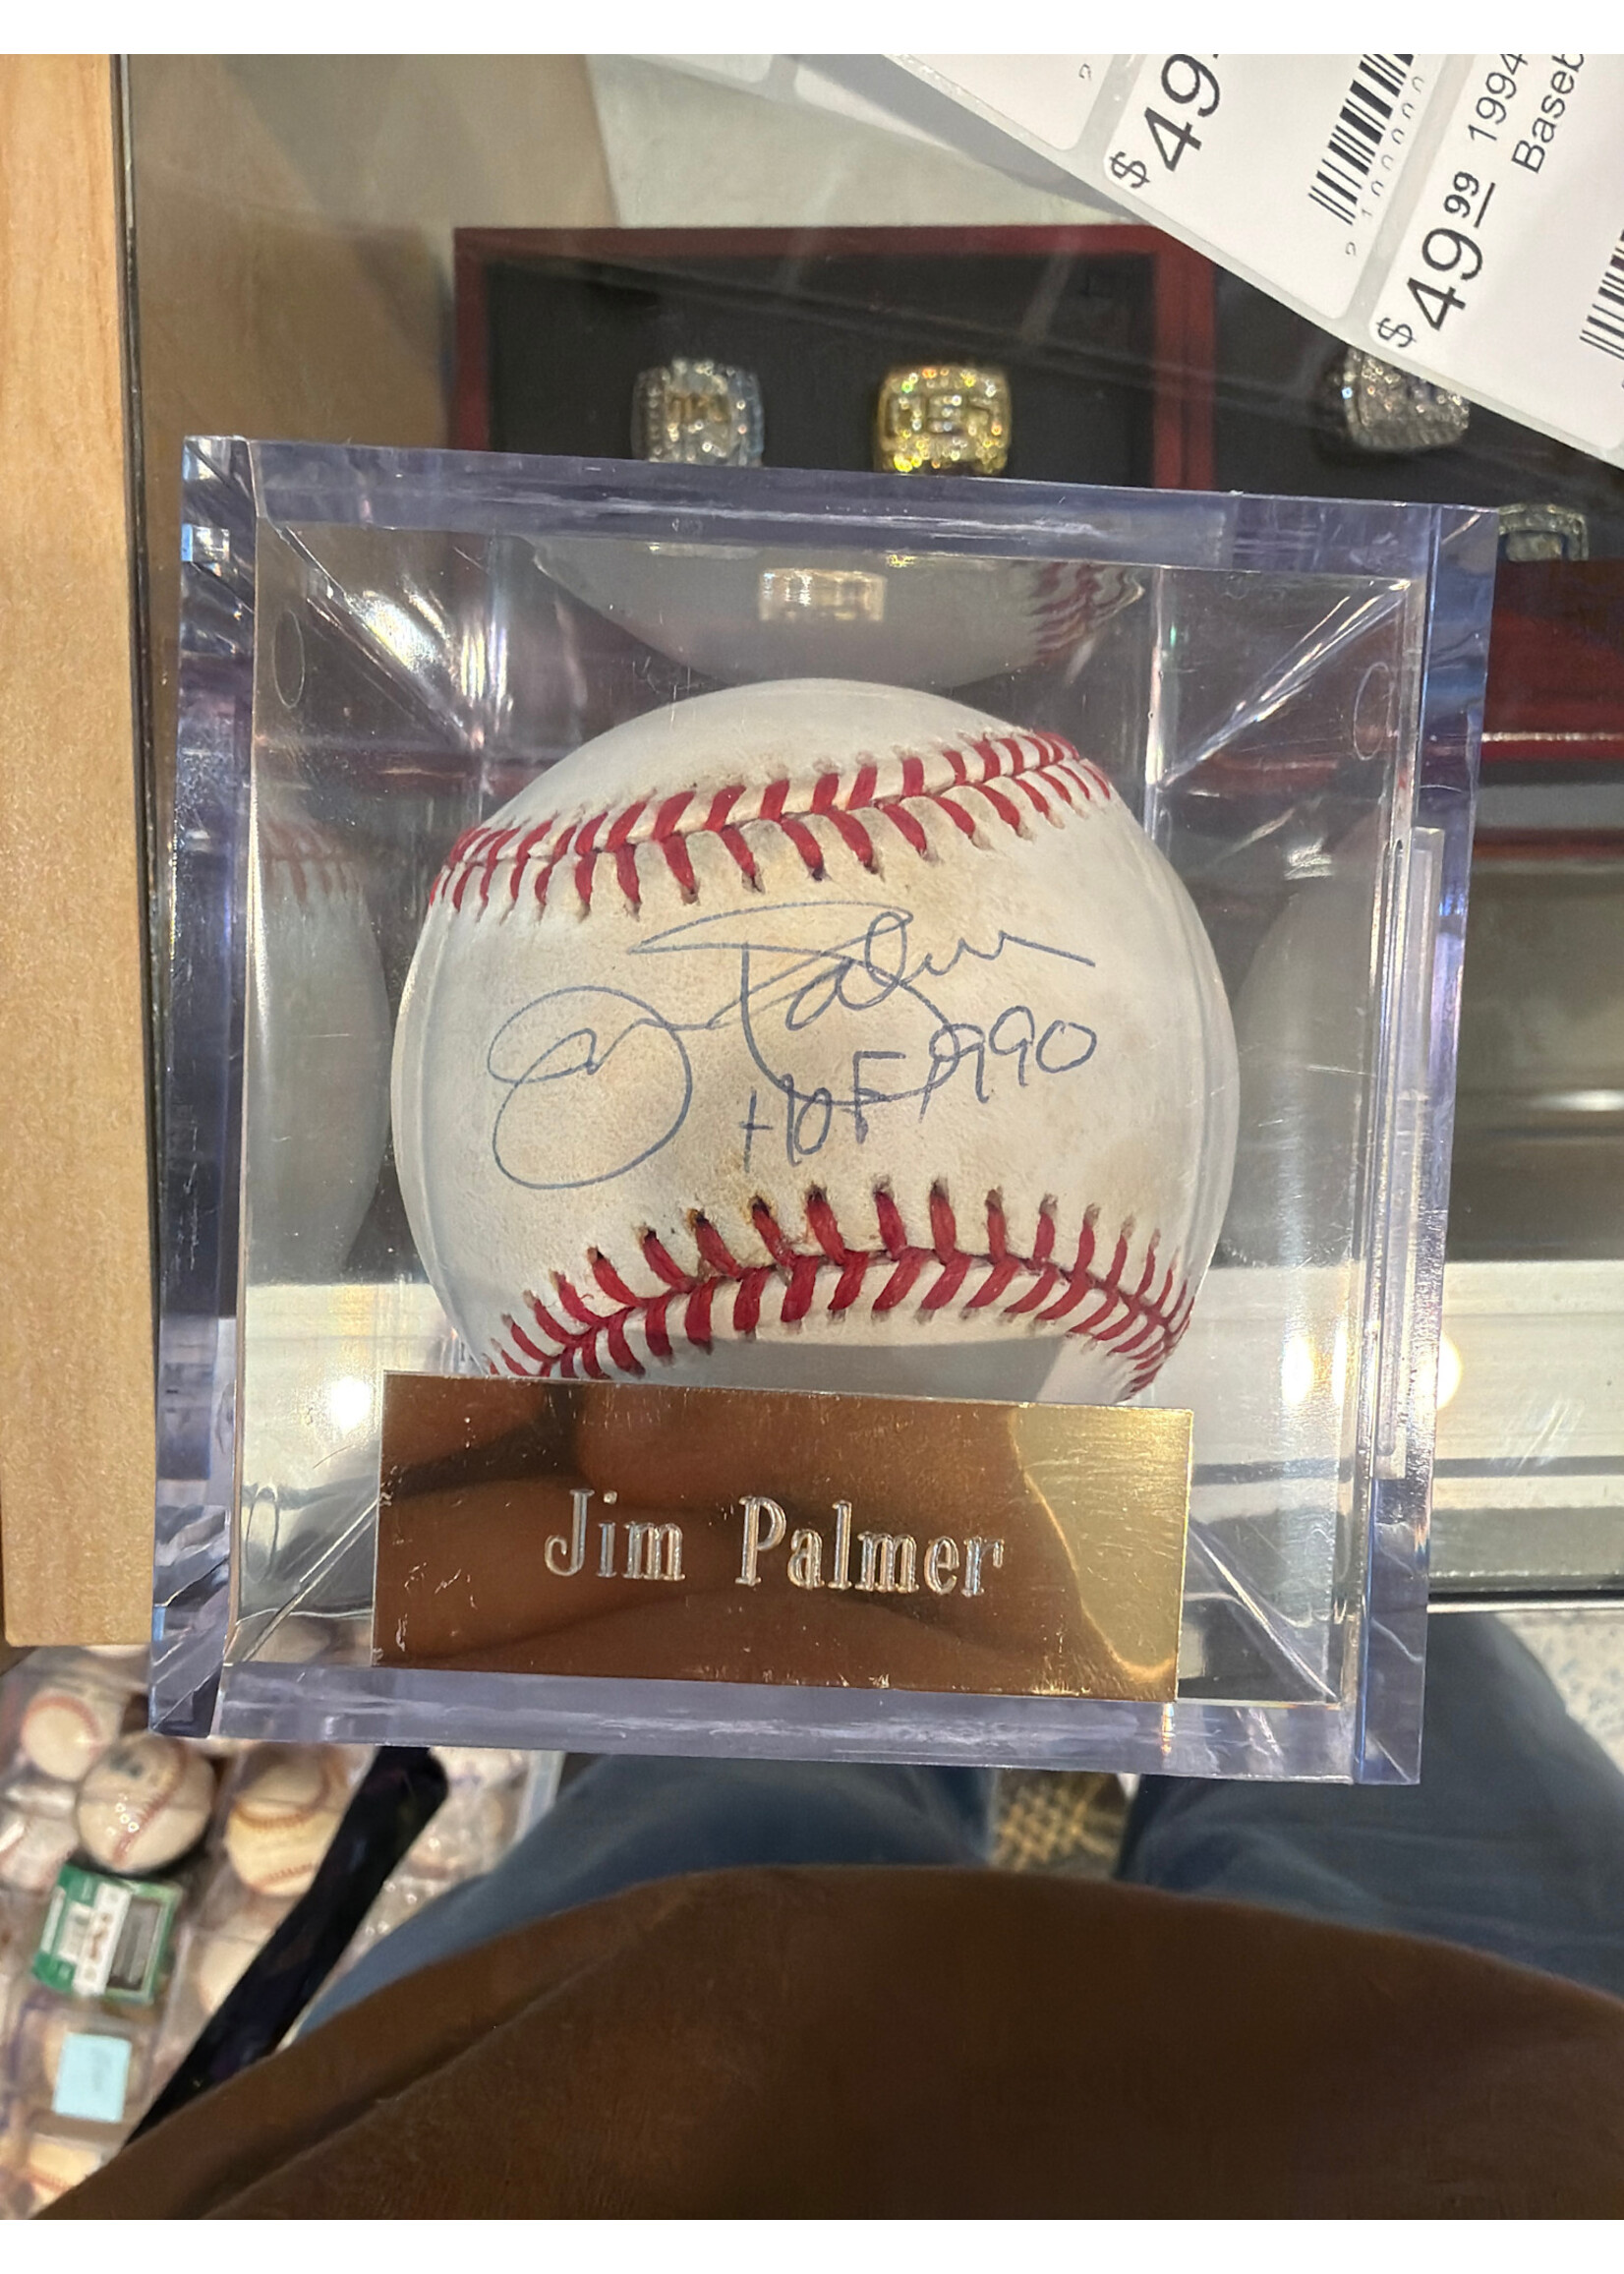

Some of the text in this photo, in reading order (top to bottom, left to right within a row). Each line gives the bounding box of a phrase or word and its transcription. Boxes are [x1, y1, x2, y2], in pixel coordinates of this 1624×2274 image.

[1468, 54, 1529, 141] 1994
[1511, 54, 1585, 174] Baseb
[917, 1005, 1098, 1123] 1990
[544, 1488, 1005, 1597] Jim Palmer
